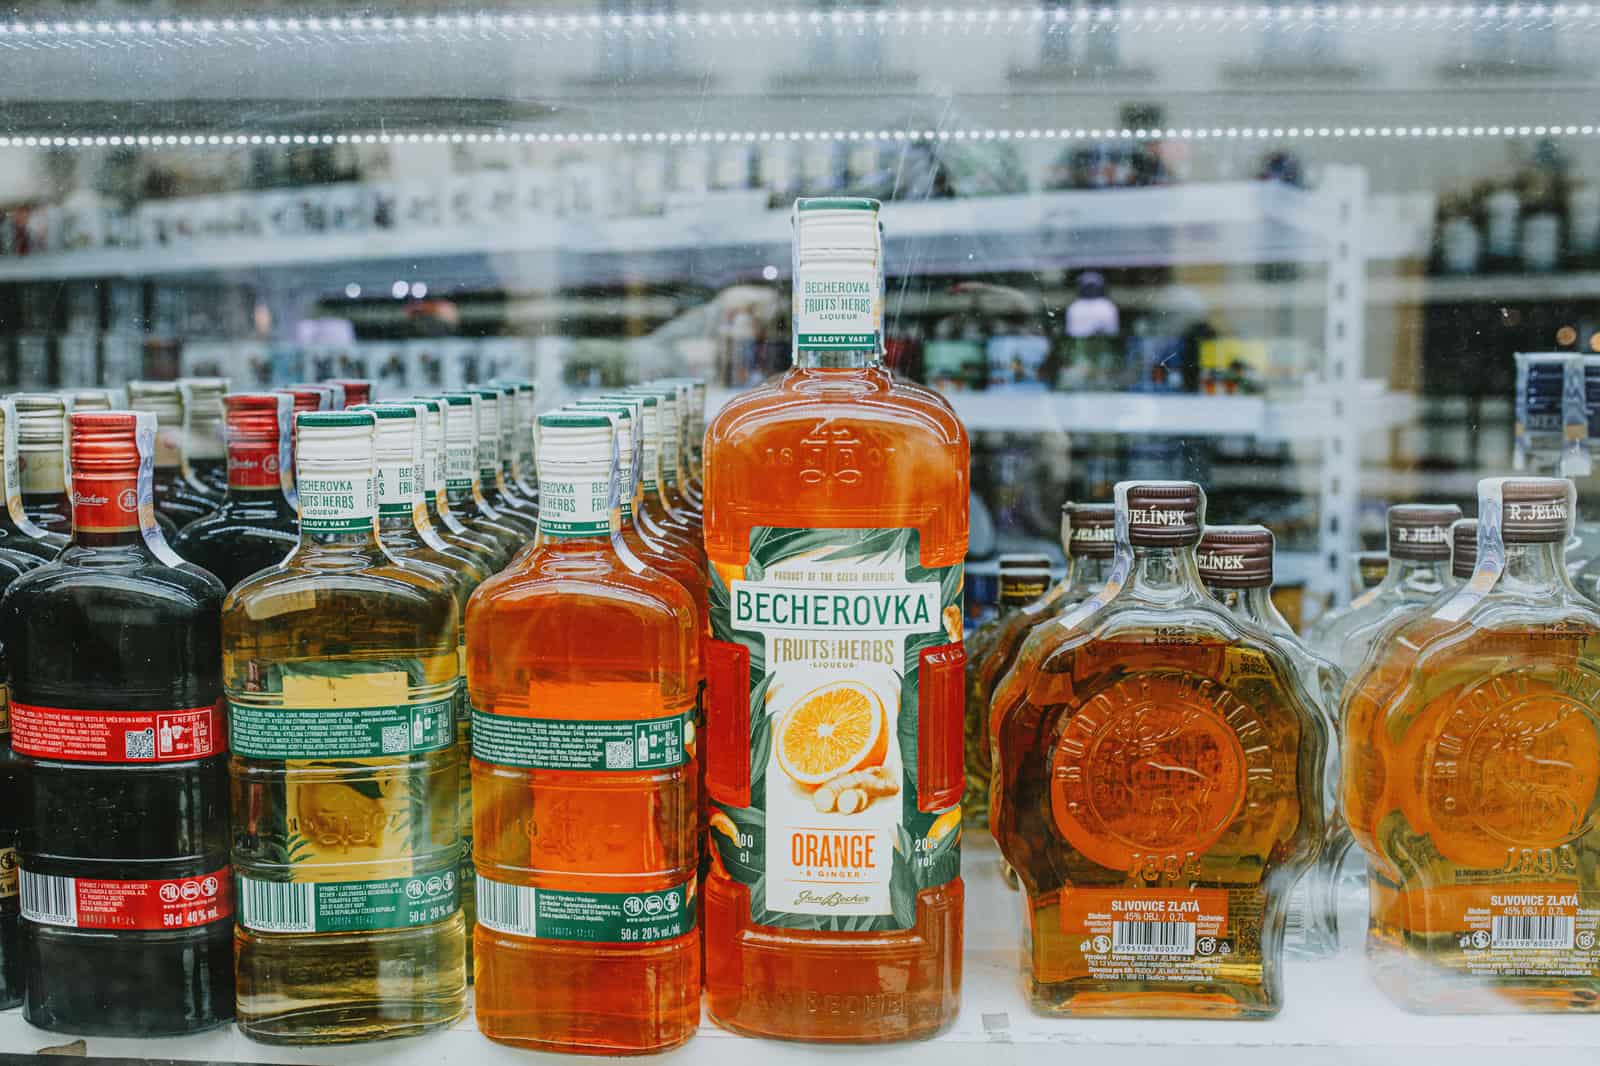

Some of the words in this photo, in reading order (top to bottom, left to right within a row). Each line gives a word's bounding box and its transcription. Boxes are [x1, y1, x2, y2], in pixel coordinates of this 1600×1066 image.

[805, 281, 870, 294] BECHEROVKA
[805, 297, 836, 314] FRUITS
[841, 298, 870, 314] HERBS
[819, 313, 857, 321] LIQUEUR
[808, 335, 845, 343] KARLOVY
[848, 335, 868, 343] VARY
[323, 496, 354, 509] HERBS
[1127, 504, 1185, 526] JELÍNEK
[329, 519, 351, 527] VARY
[1197, 550, 1244, 569] ELÍNEK
[736, 589, 930, 626] BECHEROVKA
[773, 637, 830, 664] FRUITS
[838, 639, 895, 665] HERBS
[791, 832, 876, 868] ORANGE
[739, 850, 749, 864] cl
[818, 870, 860, 879] GINGER
[1111, 900, 1165, 911] SLIVOVICE
[1168, 899, 1200, 912] ZLATÁ
[1491, 895, 1545, 906] SLIVOVICE
[1547, 892, 1579, 906] ZLATÁ
[164, 914, 174, 926] 50
[621, 928, 631, 940] 50
